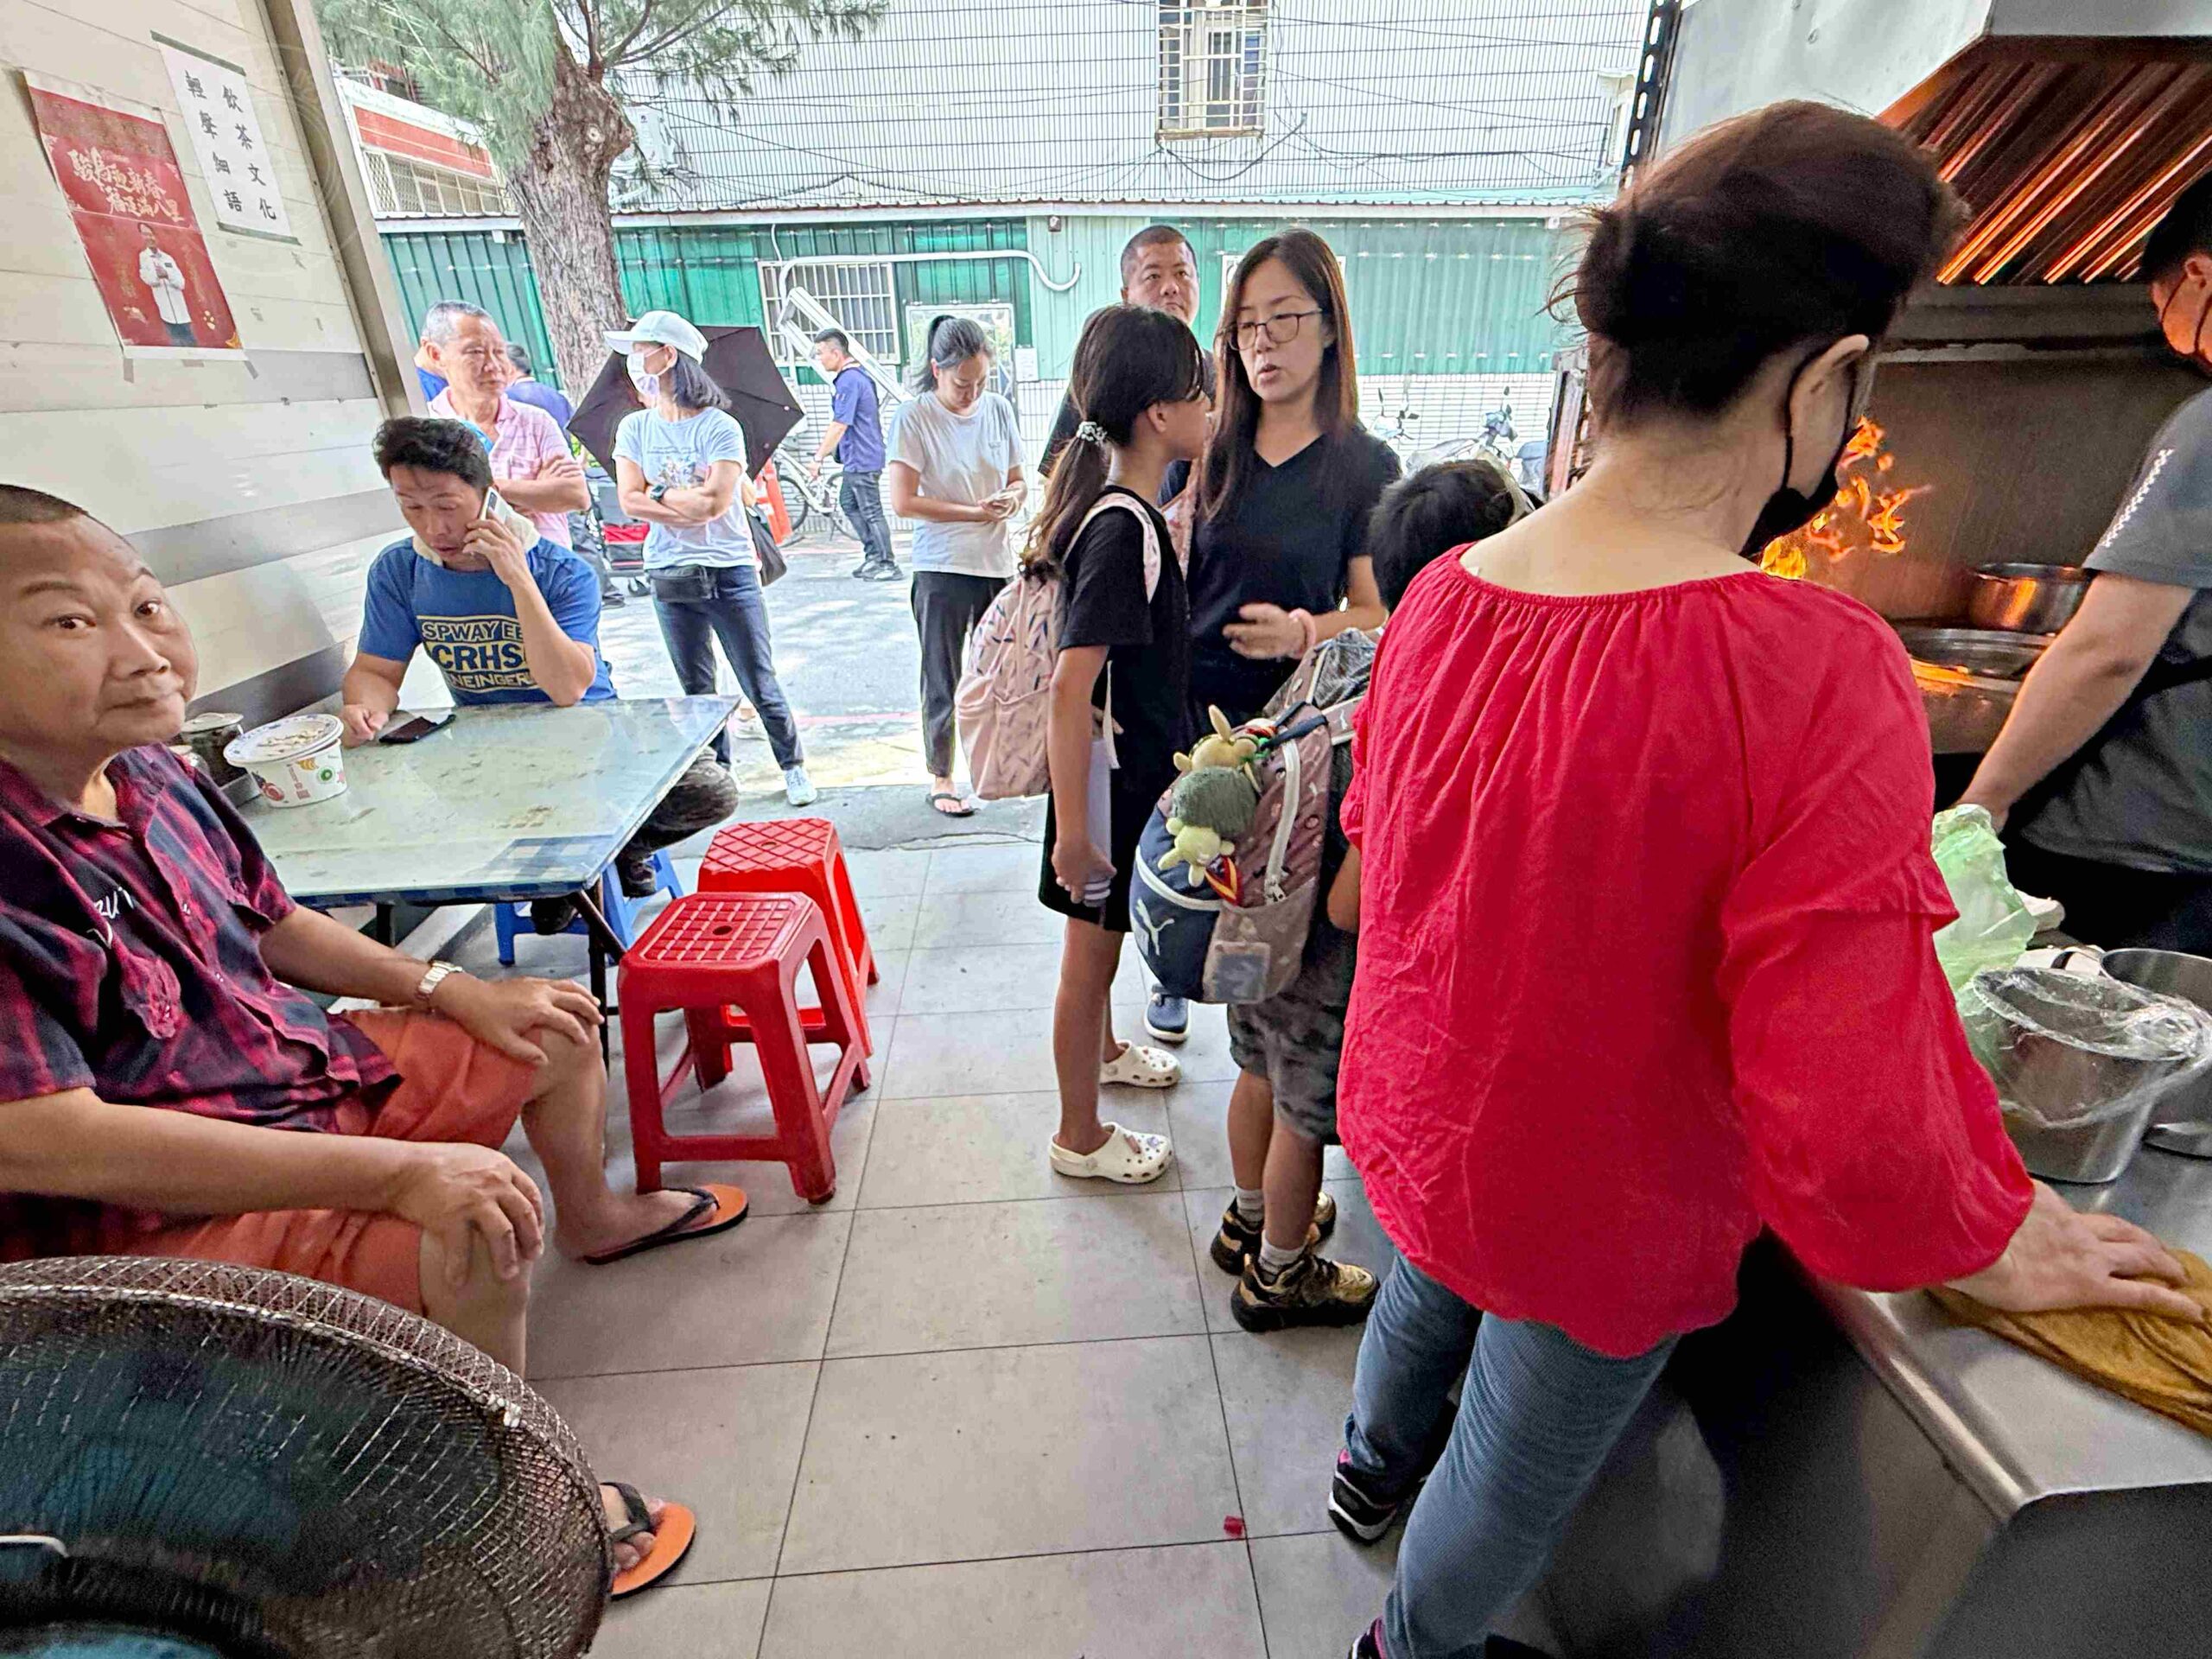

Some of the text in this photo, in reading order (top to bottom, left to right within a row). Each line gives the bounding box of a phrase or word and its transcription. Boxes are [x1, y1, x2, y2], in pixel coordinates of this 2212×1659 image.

[185, 70, 243, 213] 輕聲細語
[223, 85, 276, 220] 飲茶文化
[432, 642, 524, 671] CRHS
